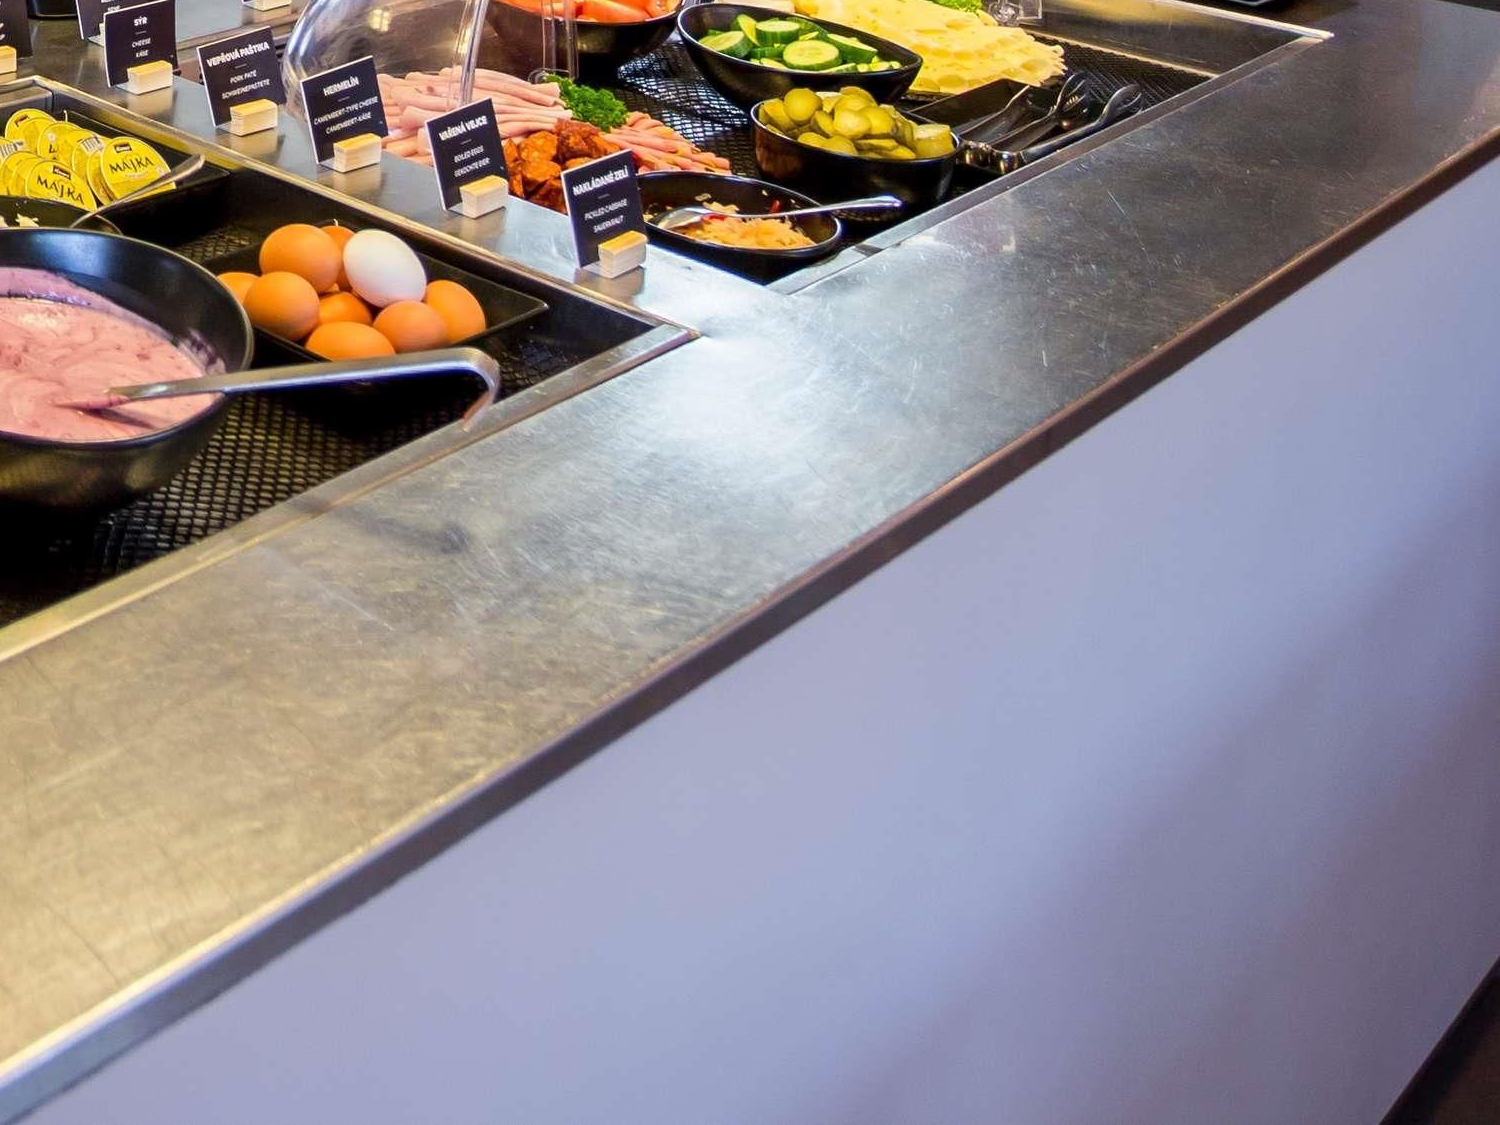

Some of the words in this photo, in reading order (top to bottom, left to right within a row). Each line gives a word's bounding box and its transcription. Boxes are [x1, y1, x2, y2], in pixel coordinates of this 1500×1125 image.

[133, 15, 148, 26] SÝR
[131, 37, 151, 48] CHEESE
[206, 48, 240, 67] VEPŘOVÁ
[240, 41, 270, 57] PAŠTIKA
[323, 75, 359, 96] HERMELÍN
[465, 115, 488, 131] VEJCE
